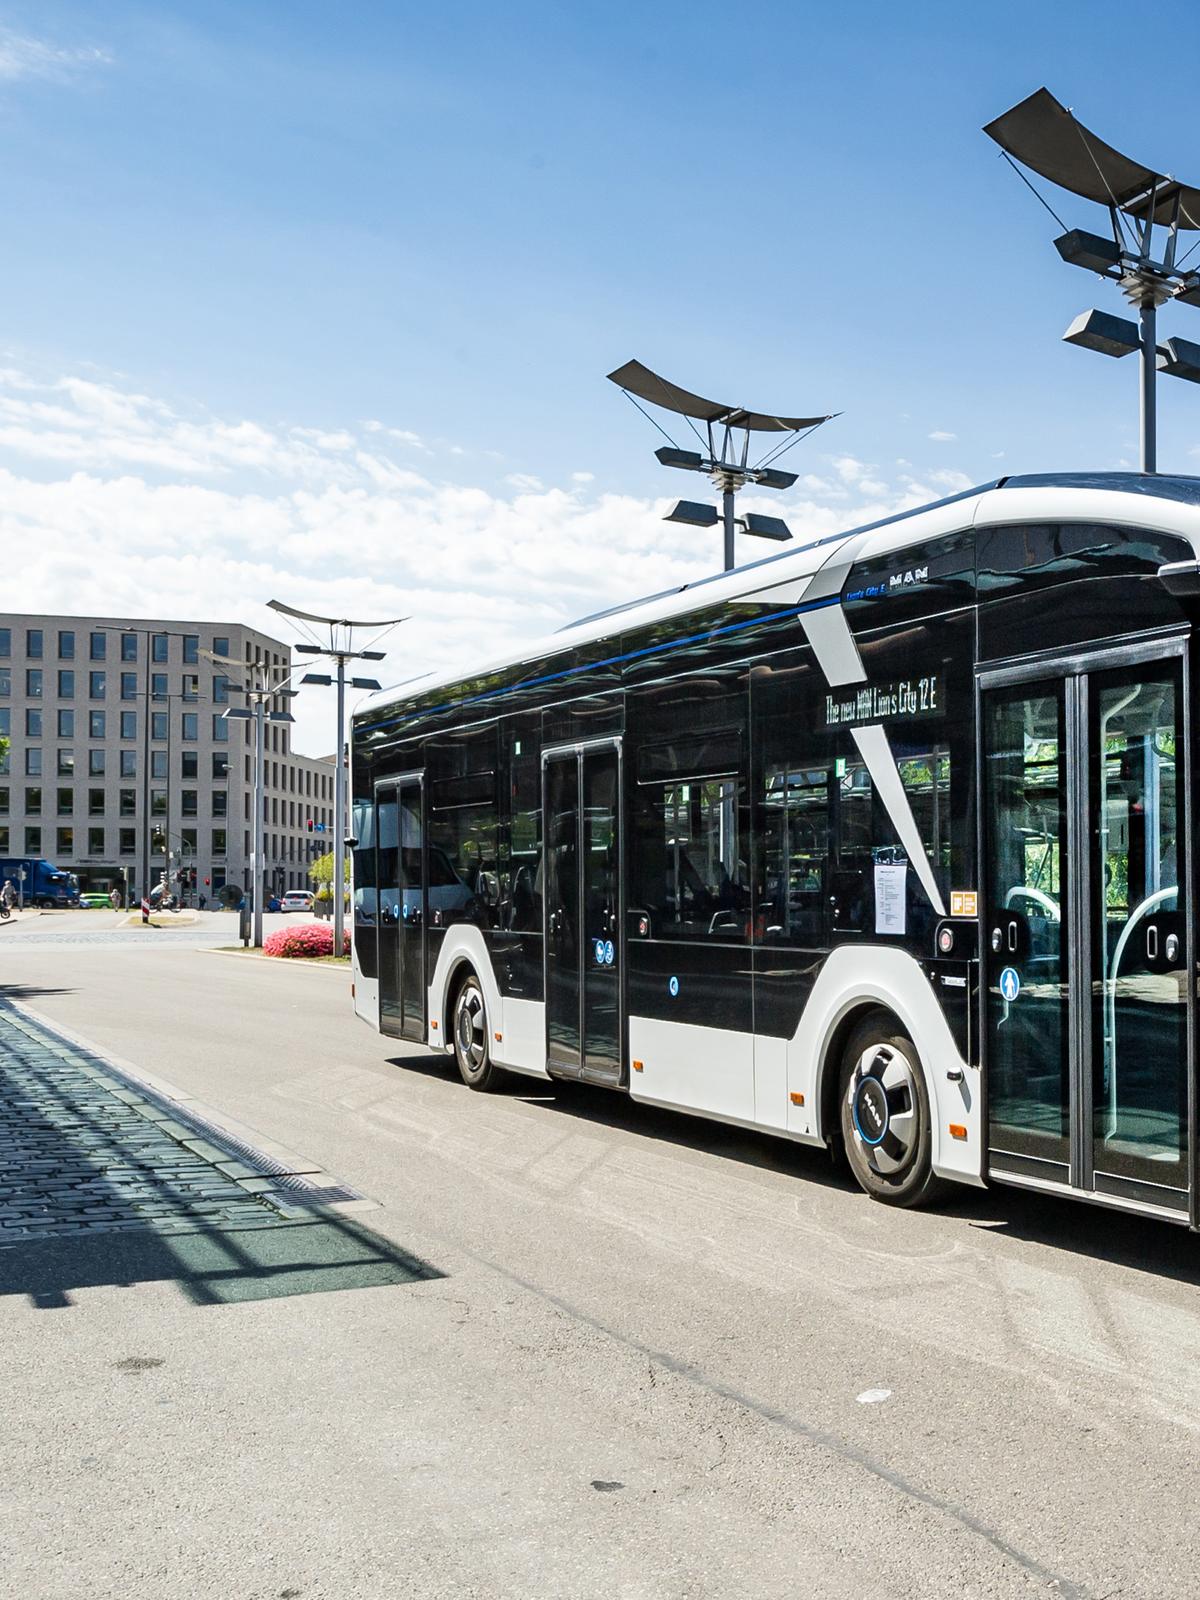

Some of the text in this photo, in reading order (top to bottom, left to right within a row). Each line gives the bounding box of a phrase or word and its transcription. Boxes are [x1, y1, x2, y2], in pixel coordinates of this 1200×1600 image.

[889, 566, 929, 590] MAN
[826, 676, 937, 725] The new MAN Lion's City 12 E
[864, 1092, 882, 1127] MAN
